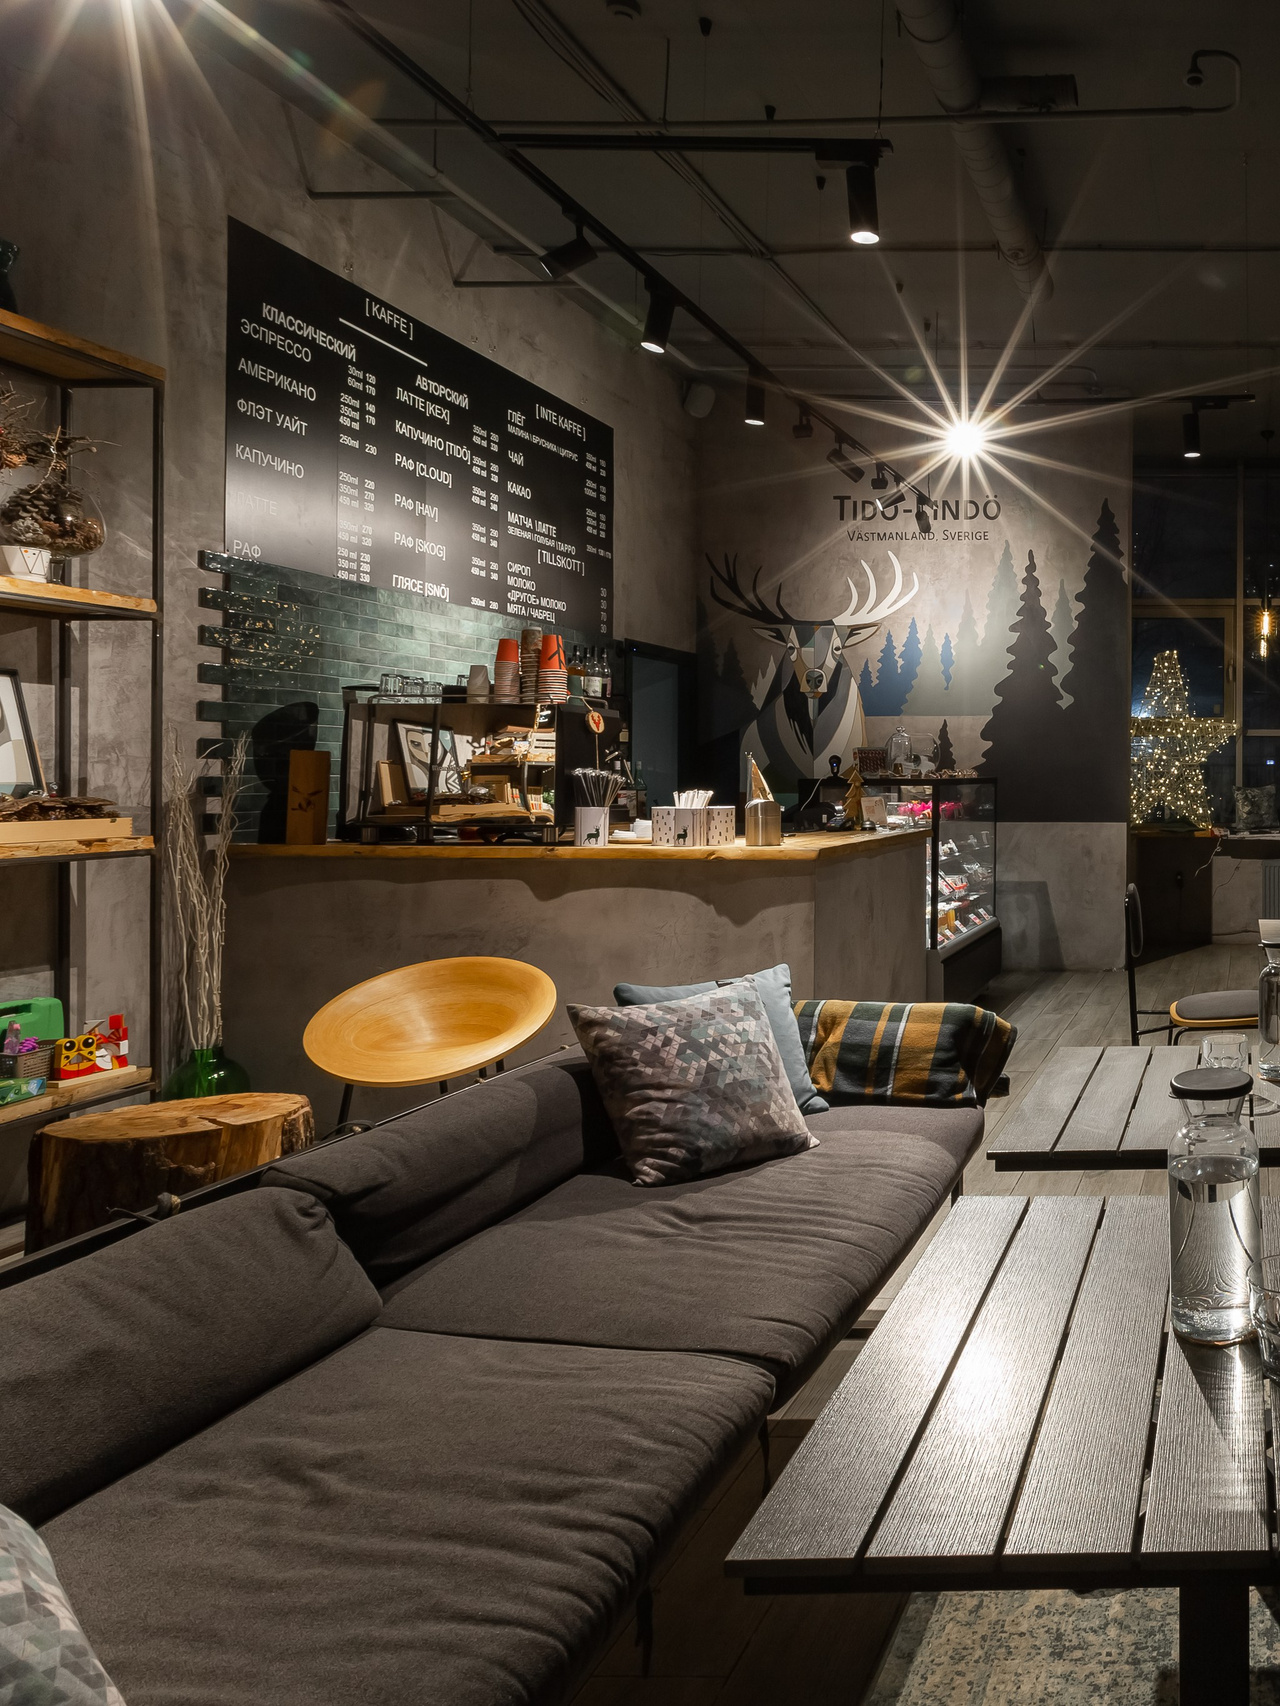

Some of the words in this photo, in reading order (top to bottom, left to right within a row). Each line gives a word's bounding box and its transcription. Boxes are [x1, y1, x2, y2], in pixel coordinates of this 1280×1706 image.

[372, 302, 407, 334] KAFFE
[240, 318, 312, 362] ЭСПРЕССО
[262, 302, 356, 362] КЛАССИЧЕСКИЙ
[238, 358, 316, 402] АМЕРИКАНО
[348, 365, 363, 379] 30ml
[366, 374, 376, 384] 120
[366, 385, 376, 396] 170
[396, 386, 425, 412] ЛАТТЕ
[416, 374, 468, 410] АВТОРСКИЙ
[340, 393, 360, 408] 250ml
[236, 398, 273, 423] ФЛЭТ
[276, 412, 308, 436] УАЙТ
[340, 405, 360, 420] 350ml
[366, 415, 376, 426] 170
[508, 409, 526, 426] ГЛЁГ
[540, 406, 557, 425] INTE
[558, 415, 582, 437] KAFFE
[340, 434, 359, 449] 250ml
[365, 444, 378, 456] 230
[396, 420, 444, 451] КАПУЧИНО
[508, 424, 529, 440] МАЛИНА
[532, 435, 557, 452] БРУСНИКА
[560, 447, 578, 461] ЦИТРУС
[236, 443, 304, 479] КАПУЧИНО
[395, 453, 414, 471] РАФ
[508, 450, 524, 466] ЧАЙ
[339, 471, 358, 485] 250ml
[339, 483, 358, 497] 350ml
[508, 481, 531, 499] КАКАО
[394, 493, 414, 511] РАФ
[832, 494, 1002, 521] TID-INDÖ
[508, 511, 533, 529] МАТЧА
[394, 532, 414, 548] РАФ
[507, 526, 531, 540] ЗЕЛЕНАЯ
[233, 540, 262, 559] РАФ
[507, 562, 531, 577] СИРОП
[542, 550, 581, 572] TILLSKOTT
[392, 574, 423, 594] ГЛЯСЕ
[507, 575, 536, 591] МОЛОКО
[507, 603, 526, 616] МЯТА
[530, 608, 555, 624] ЧАБРЕЦ
[540, 597, 567, 612] МОЛОКО
